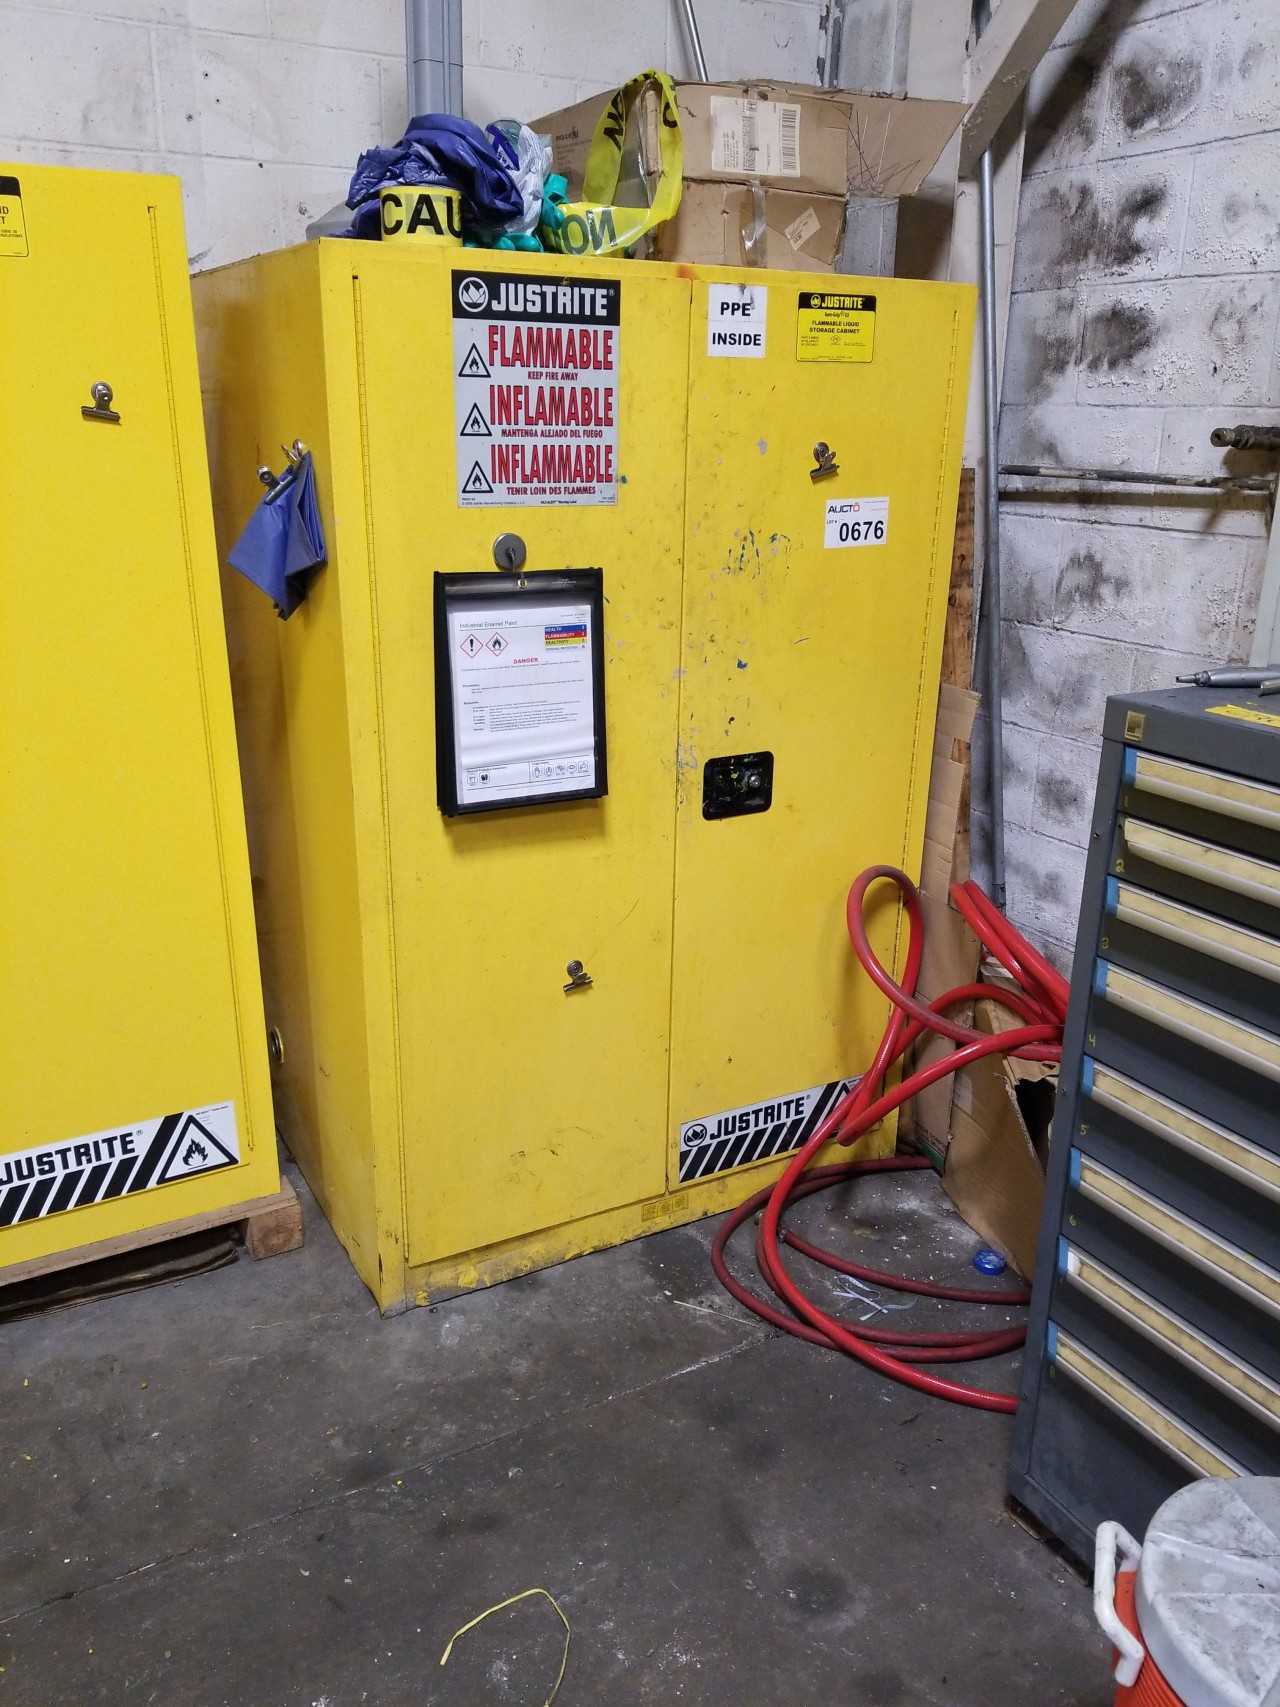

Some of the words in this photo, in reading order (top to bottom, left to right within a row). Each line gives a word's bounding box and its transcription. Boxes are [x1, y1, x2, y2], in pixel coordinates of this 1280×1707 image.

[492, 282, 608, 316] JUSTRITE
[821, 296, 863, 309] JUSTRITE
[720, 302, 751, 316] PPE
[488, 325, 613, 370] FLAMMABLE
[712, 332, 762, 346] INSIDE
[528, 371, 544, 380] KEEP
[545, 372, 559, 381] FIRE
[561, 372, 578, 381] AWAY
[489, 385, 614, 426] INFLAMABLE
[501, 428, 538, 438] MANTENGA
[540, 429, 568, 438] ALEJADO
[570, 429, 581, 438] DEL
[583, 429, 603, 438] FUEGO
[490, 444, 614, 484] INFLAMMABLE
[506, 487, 528, 496] TENIR
[530, 486, 547, 495] LOIN
[550, 486, 562, 495] DES
[563, 486, 596, 495] FLAMMES
[839, 520, 884, 542] 0676
[513, 657, 538, 665] DANGER
[709, 1096, 805, 1141] JUSTRITE
[0, 1130, 136, 1186] JUSTRITE
